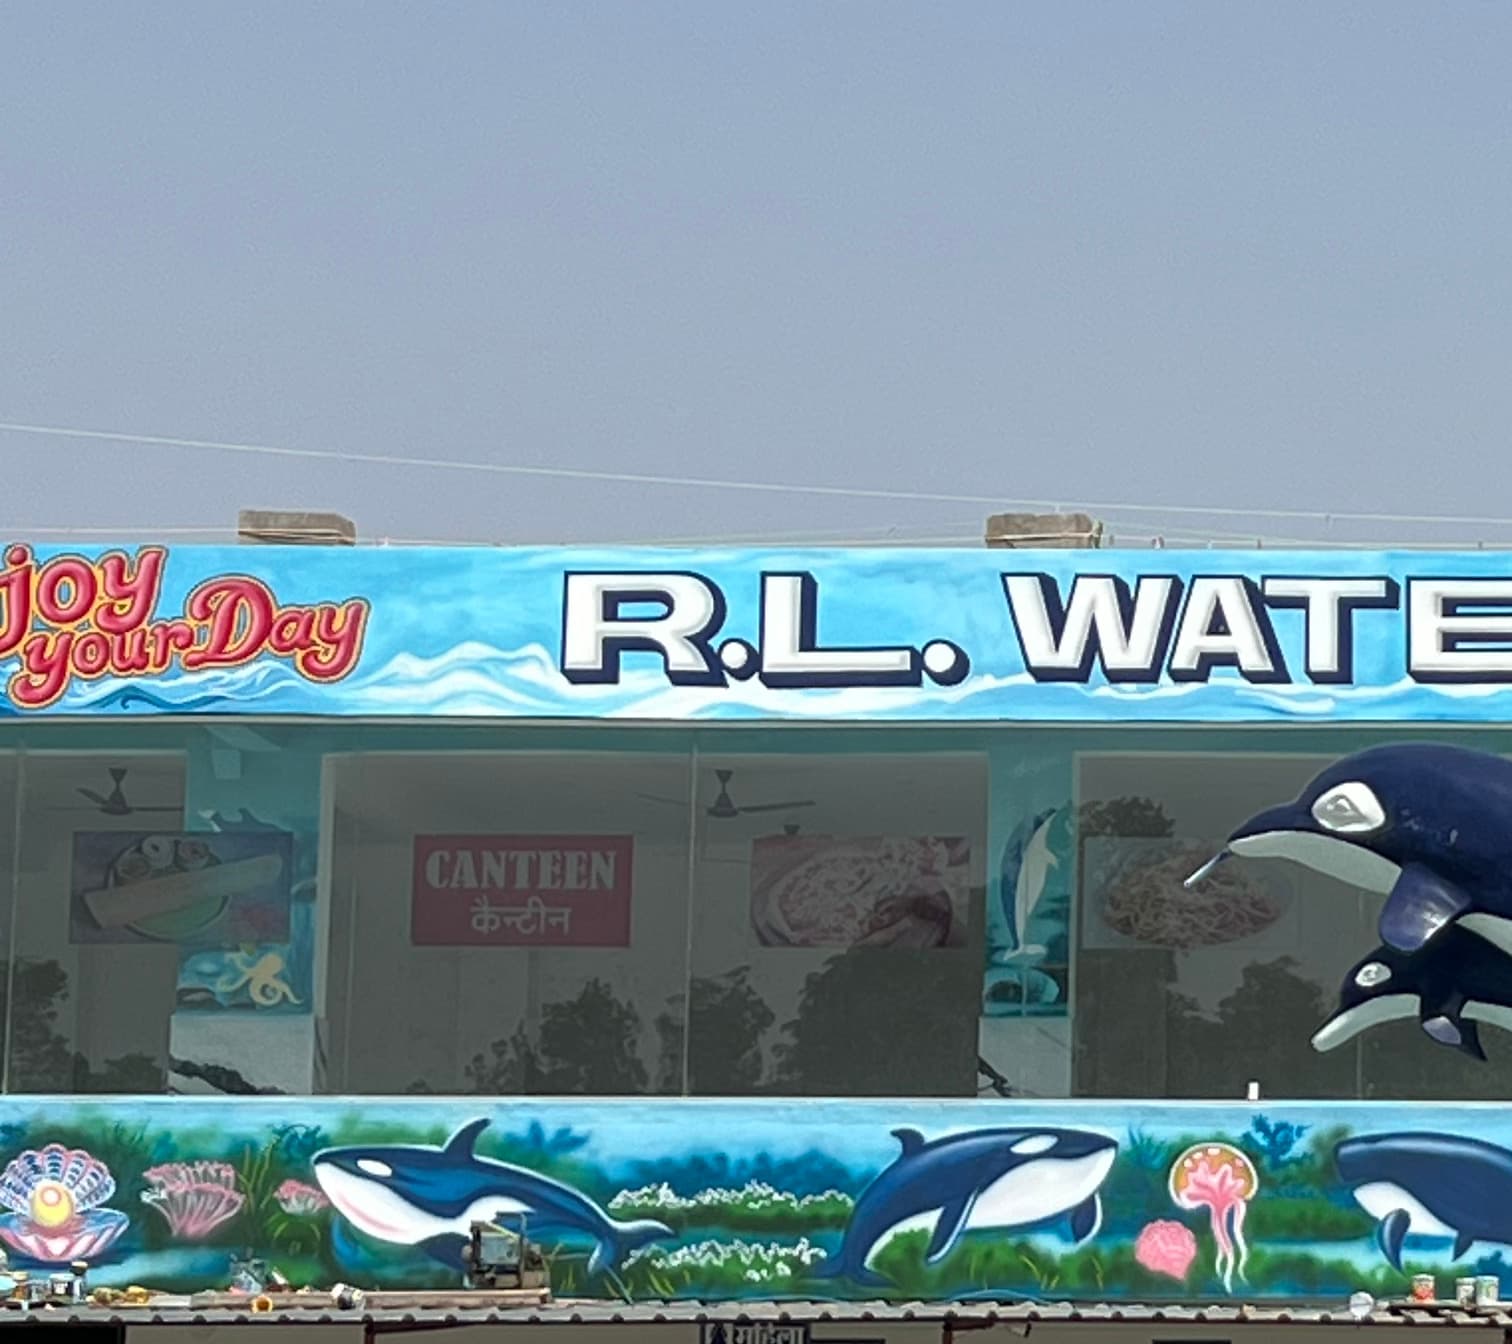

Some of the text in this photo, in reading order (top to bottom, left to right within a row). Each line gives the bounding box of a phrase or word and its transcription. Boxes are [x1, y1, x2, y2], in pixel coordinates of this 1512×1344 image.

[8, 573, 370, 708] your Day
[562, 570, 970, 687] R.L.
[425, 849, 617, 890] CANTEEN
